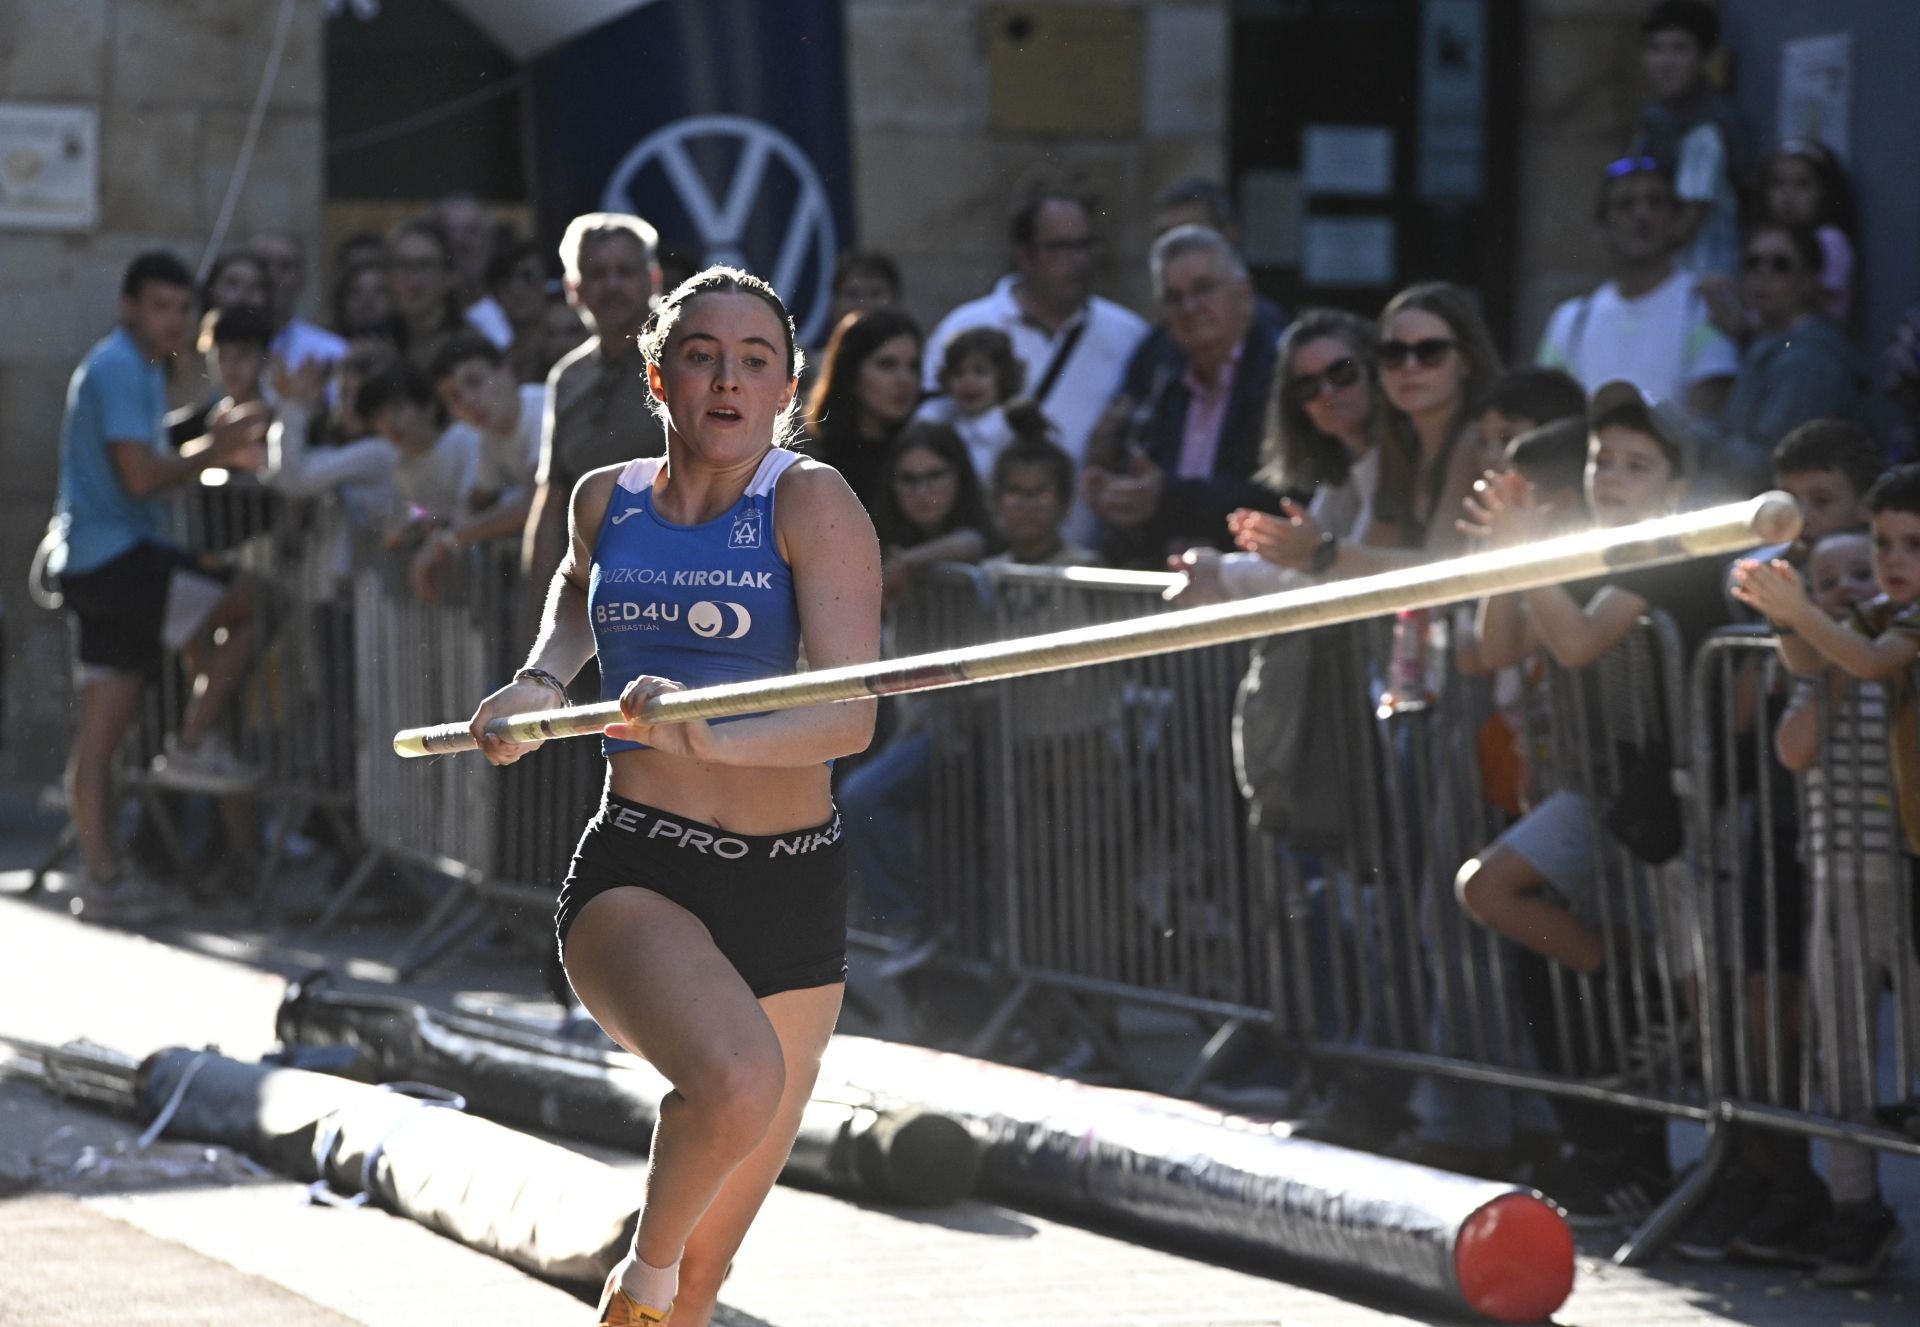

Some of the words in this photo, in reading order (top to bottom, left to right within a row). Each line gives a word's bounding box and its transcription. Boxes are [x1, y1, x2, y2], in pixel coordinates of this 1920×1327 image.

[672, 570, 772, 589] KIROLAK
[596, 602, 679, 623] BED4U
[647, 819, 749, 859] PRO
